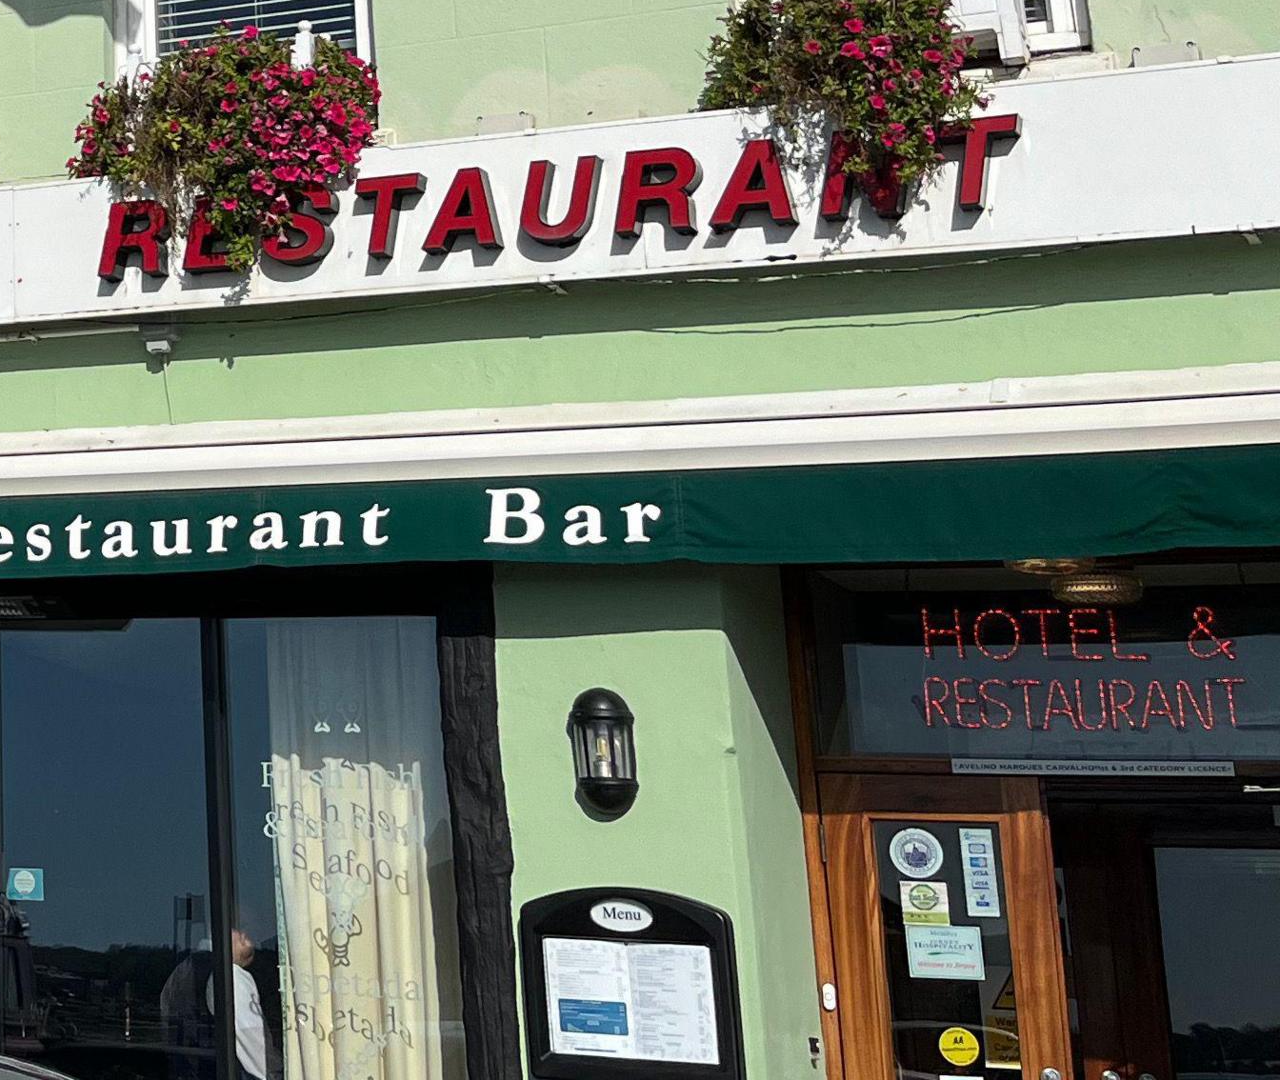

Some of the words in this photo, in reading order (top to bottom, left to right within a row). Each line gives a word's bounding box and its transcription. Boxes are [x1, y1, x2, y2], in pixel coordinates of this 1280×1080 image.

[482, 486, 662, 547] Bar
[920, 606, 1151, 661] HOTEL
[1186, 605, 1237, 661] &
[921, 675, 1247, 732] RESTAURANT
[602, 906, 642, 921] Menu
